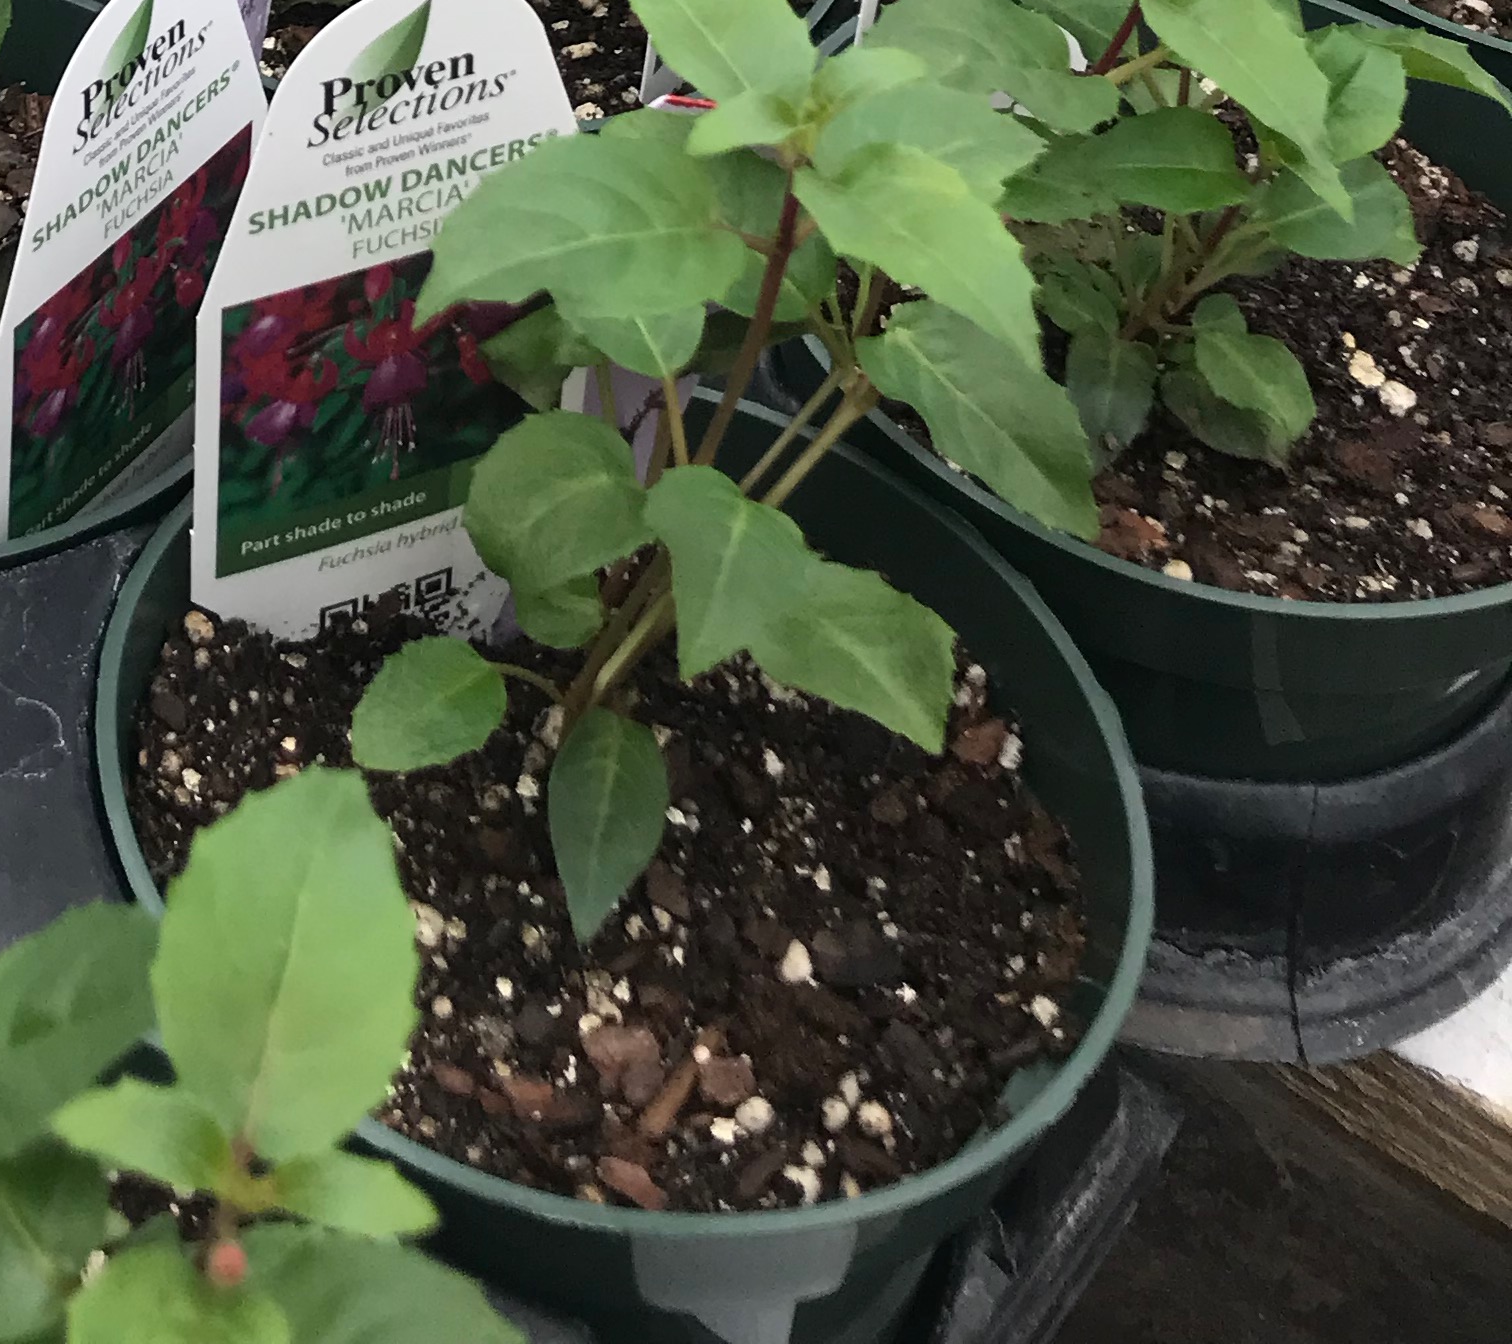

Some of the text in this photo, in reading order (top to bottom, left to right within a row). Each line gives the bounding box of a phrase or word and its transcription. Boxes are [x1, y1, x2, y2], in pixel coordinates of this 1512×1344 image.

[72, 23, 211, 155] Selections
[80, 18, 186, 119] Proven
[320, 52, 474, 114] Proven
[307, 71, 510, 149] Selections
[322, 112, 489, 167] Classic and Unique Favorites
[96, 133, 183, 218] 'MARCIA'
[345, 159, 373, 178] from
[376, 149, 415, 169] Proven
[32, 155, 132, 251] SHADOW
[103, 169, 174, 239] FUCHSIA
[248, 175, 392, 235] SHADOW
[341, 181, 470, 235] 'MARCIA'
[352, 215, 444, 260] FUCHSI
[241, 491, 426, 555] Part shade to shade
[318, 540, 392, 572] Fuchsia
